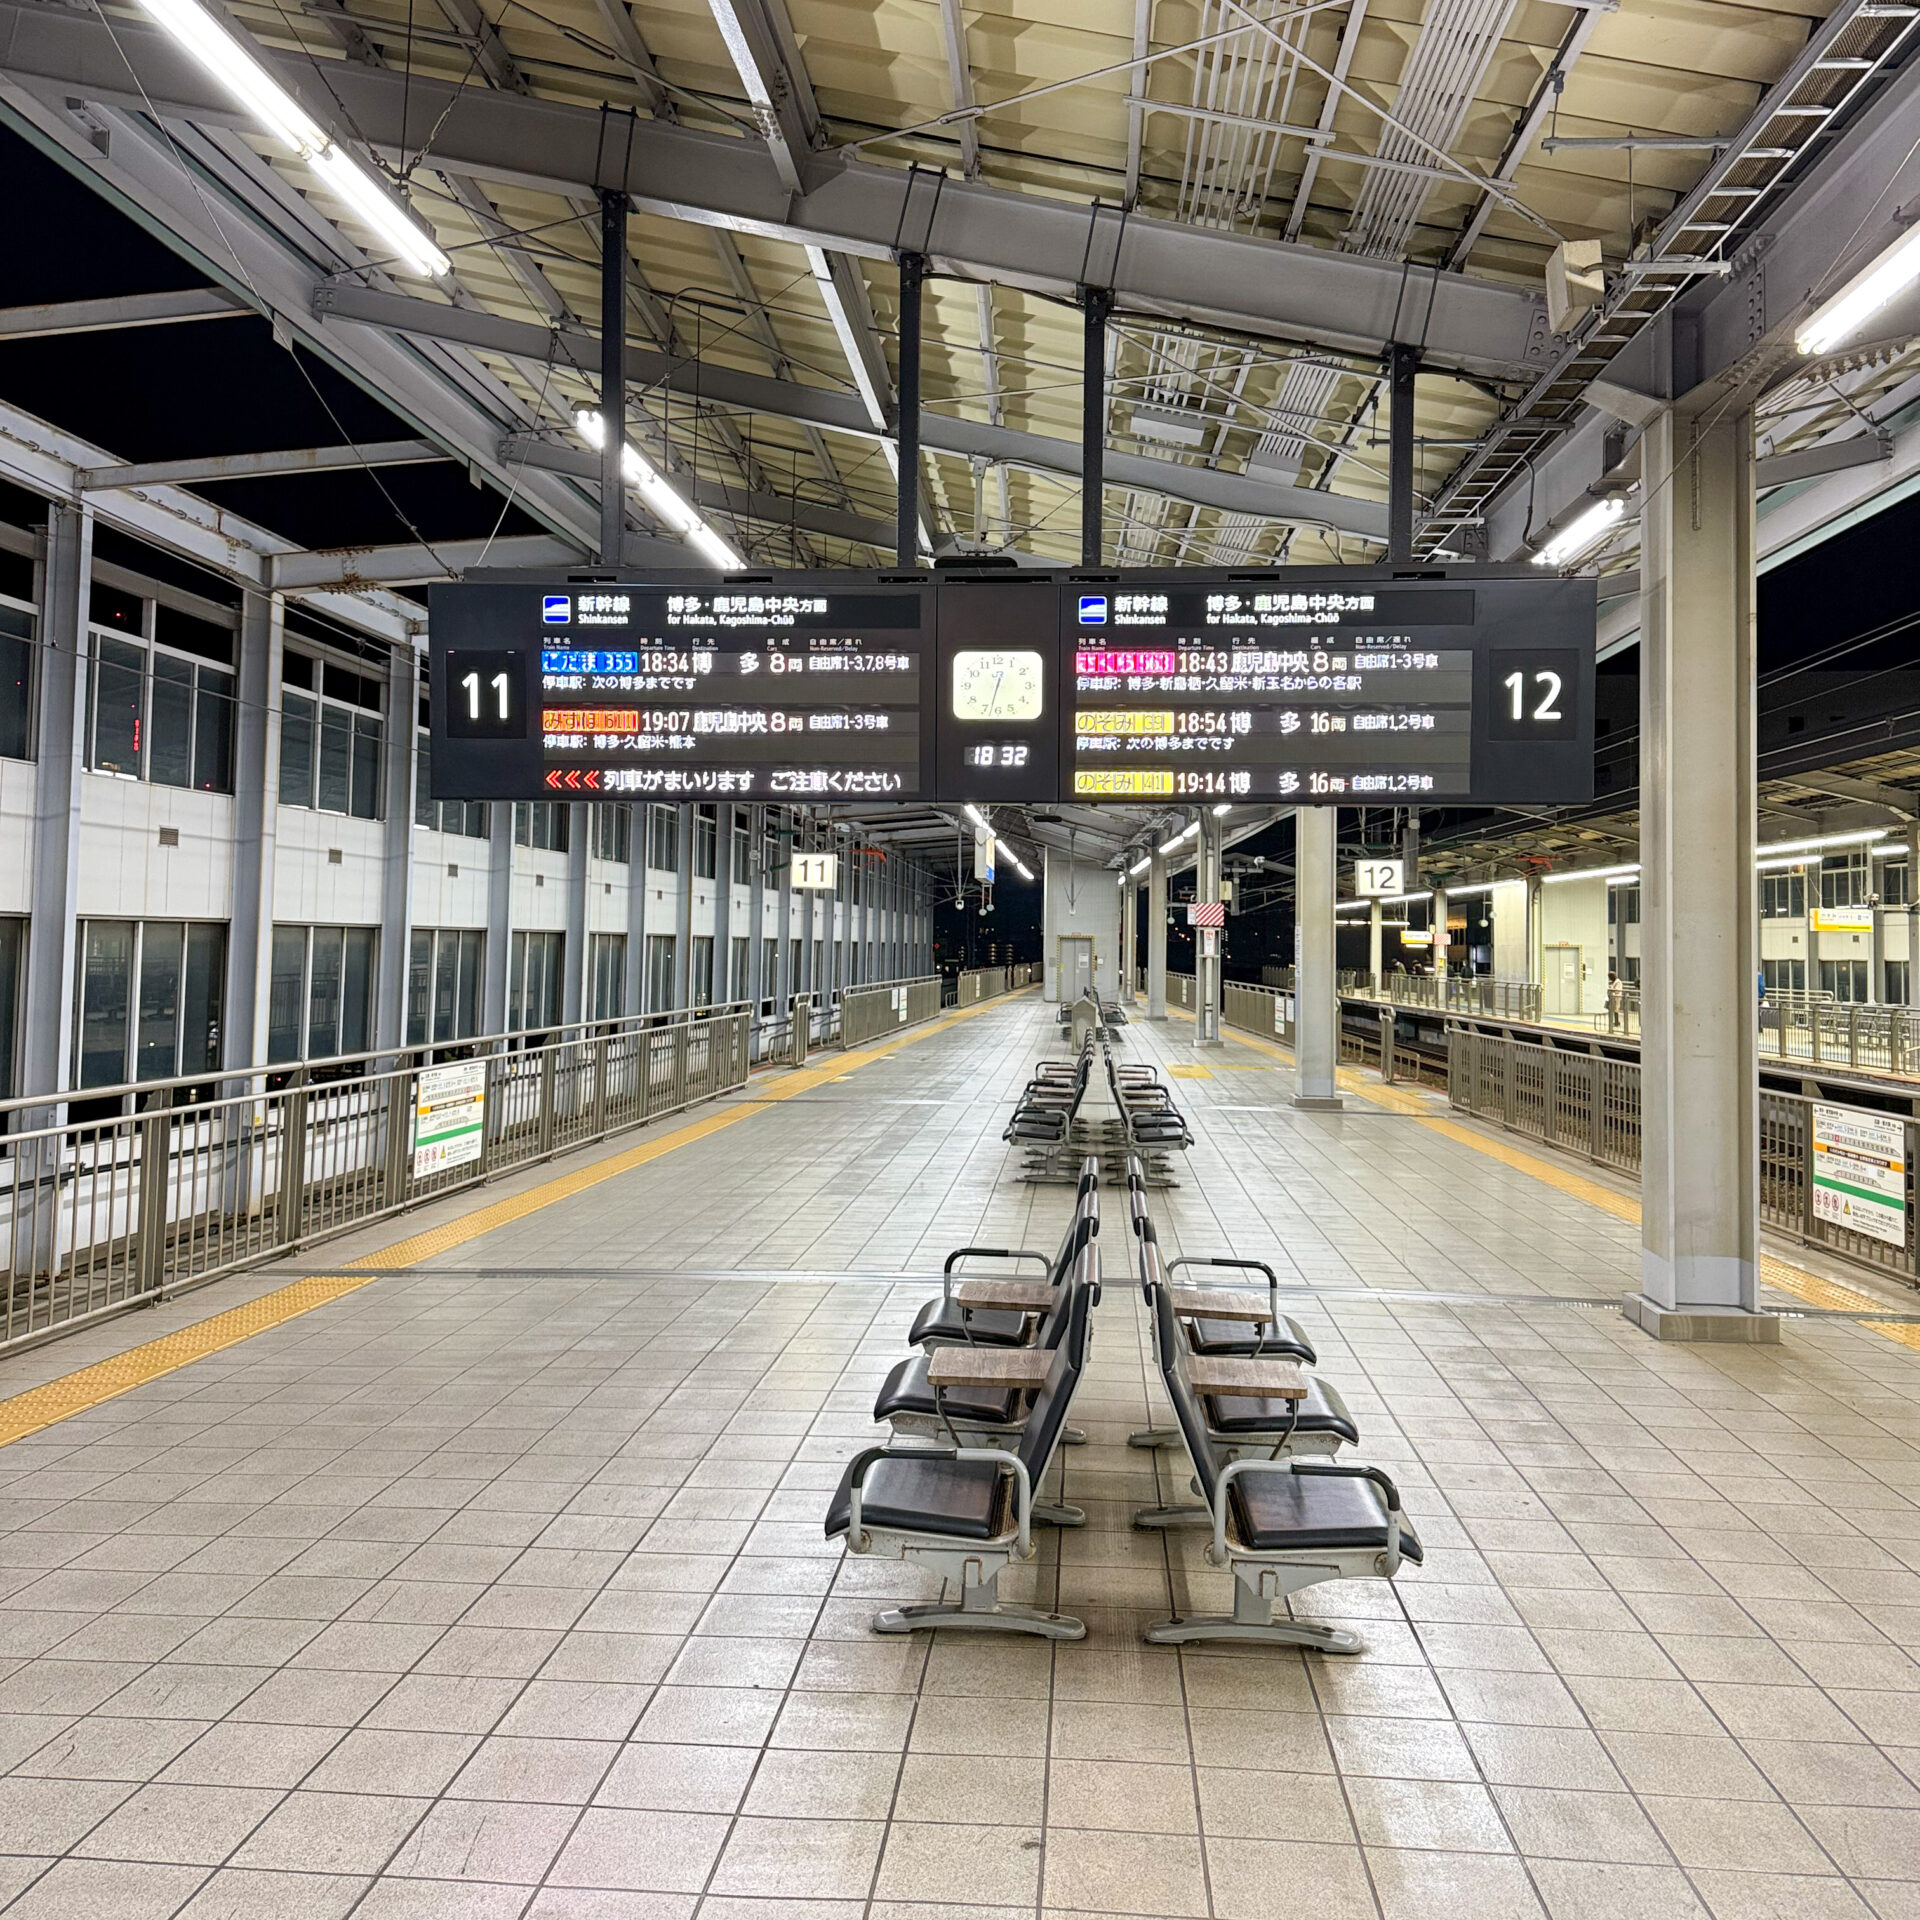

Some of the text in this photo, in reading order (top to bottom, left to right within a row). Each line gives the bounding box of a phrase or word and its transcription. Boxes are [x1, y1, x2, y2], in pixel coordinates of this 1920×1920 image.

[578, 596, 630, 612] 新幹線
[1114, 596, 1168, 612] 新幹線
[578, 614, 628, 625] Shinkansen
[667, 614, 680, 625] for
[683, 614, 717, 626] Hakata,
[1114, 614, 1166, 625] Shinkansen
[1206, 613, 1220, 625] for
[1223, 613, 1258, 626] Hakata,
[543, 653, 597, 672] こだま
[641, 652, 690, 673] 18:34
[980, 661, 990, 669] 11
[992, 657, 1004, 665] 12
[1178, 652, 1228, 673] 18:43
[1231, 651, 1309, 673] 鹿児島中央
[969, 670, 980, 678] 10
[1019, 667, 1027, 676] 2
[591, 675, 697, 690] 次の博多までです
[963, 682, 972, 690] 9
[1025, 682, 1032, 690] 3
[462, 672, 508, 719] 11
[1018, 695, 1026, 704] 4
[1504, 671, 1562, 720] 12
[981, 704, 989, 713] 7
[994, 706, 1002, 715] 6
[1007, 704, 1015, 713] 5
[641, 711, 691, 732] 19:07
[693, 711, 768, 733] 鹿児島中央
[1077, 714, 1132, 732] のぞみ
[1178, 712, 1227, 733] 18:54
[1126, 736, 1235, 750] 次の博多までです
[1000, 746, 1028, 765] 32
[603, 770, 901, 791] 列車がまいります ご注意ください
[1077, 774, 1132, 791] のぞみ
[1177, 772, 1226, 793] 19:14
[798, 859, 825, 882] 11
[1364, 866, 1396, 889] 12
